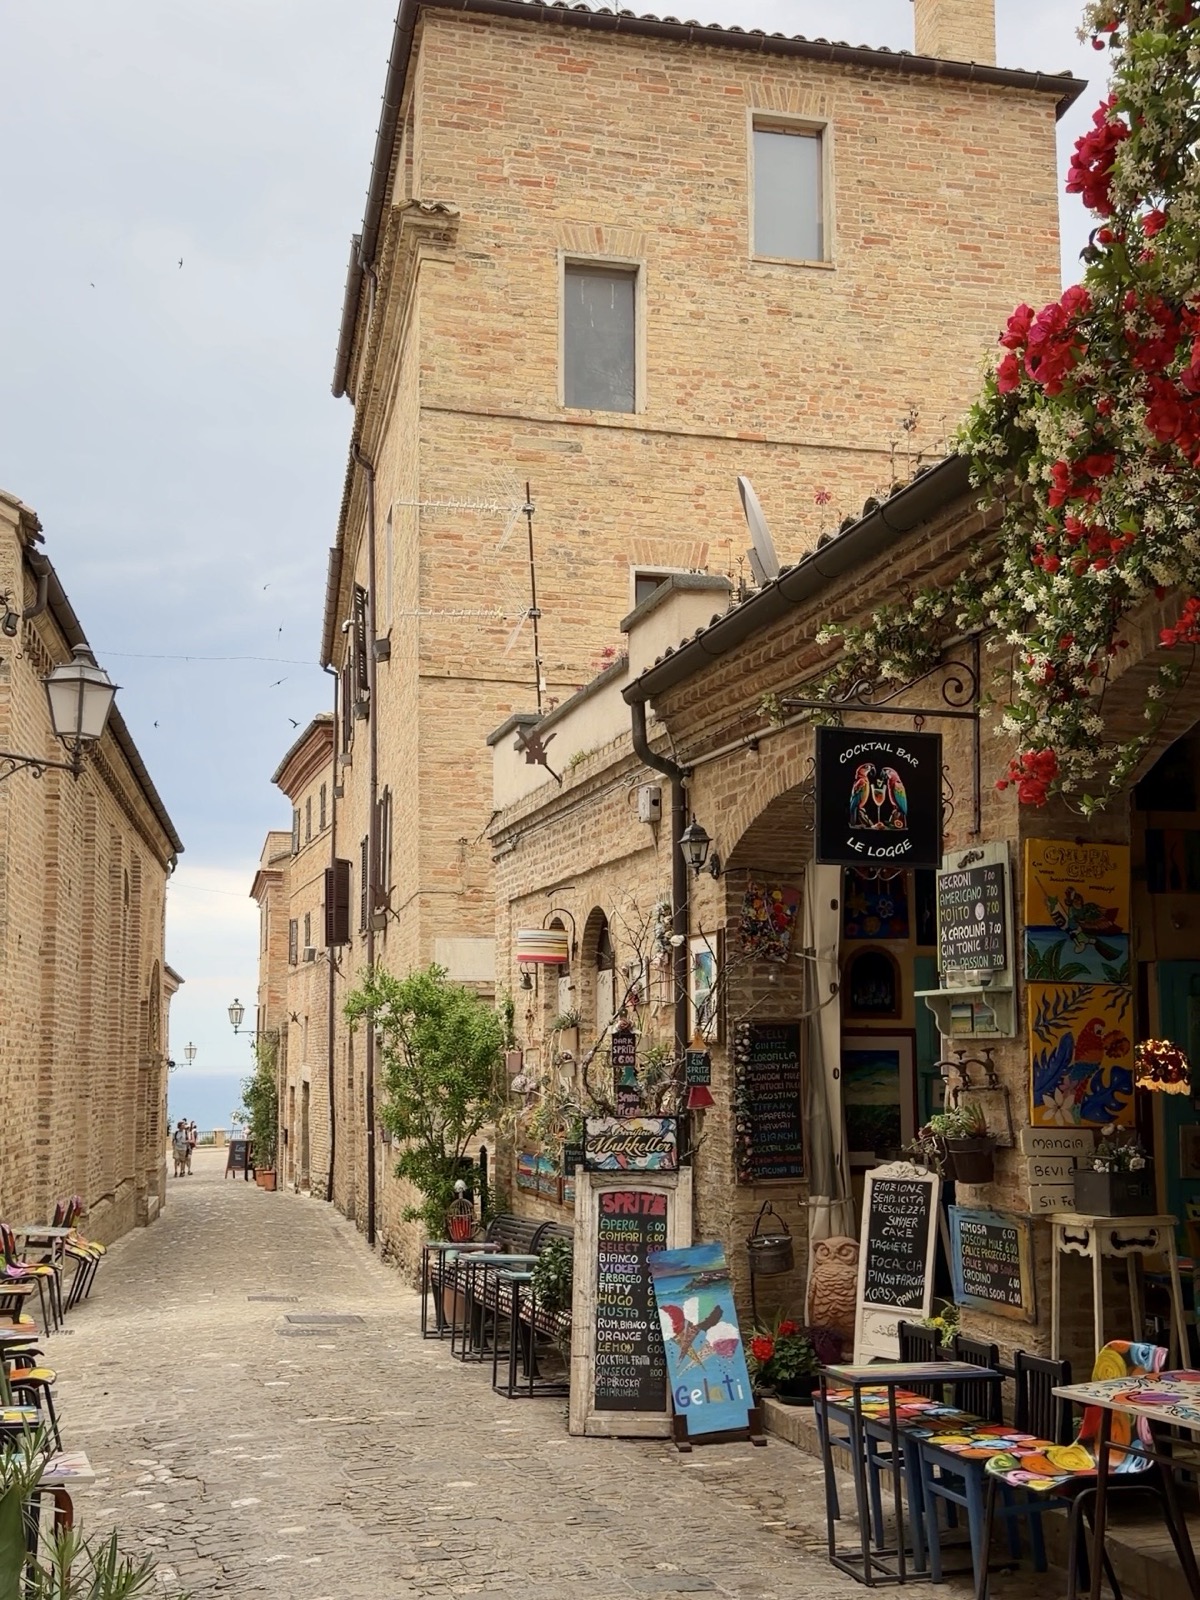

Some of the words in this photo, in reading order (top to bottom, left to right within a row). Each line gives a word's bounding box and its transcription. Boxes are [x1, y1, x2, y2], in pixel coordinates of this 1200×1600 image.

[839, 742, 893, 764] COCKTAIL
[896, 748, 919, 768] BAR
[846, 837, 865, 853] LE
[867, 838, 912, 858] LOGGE
[939, 872, 971, 892] NEGRONI
[939, 886, 982, 906] AMERICANO
[948, 921, 986, 941] CAROLINA
[941, 944, 955, 958] GIN
[956, 939, 981, 955] TONIC
[960, 954, 989, 970] PASSION
[613, 1045, 635, 1054] SPRITZ
[687, 1066, 709, 1074] SPRITZ
[759, 1121, 791, 1131] HAWAII
[760, 1131, 797, 1142] BIANCHI
[587, 1136, 672, 1157] Mukkeller
[1034, 1165, 1063, 1177] BEVI
[874, 1182, 924, 1193] EMOZIONE
[602, 1193, 667, 1216] SPRITZ
[872, 1203, 926, 1215] FRESCHEZZA
[600, 1219, 640, 1231] APEROL
[885, 1215, 918, 1228] SUMMER
[881, 1227, 914, 1238] CAKE
[960, 1222, 987, 1236] MIMOSA
[599, 1231, 642, 1243] CAMPARI
[599, 1242, 640, 1253] SELECT
[870, 1239, 913, 1254] TAGLIERE
[988, 1238, 1003, 1251] MULE
[599, 1253, 638, 1264] BIANCO
[961, 1244, 981, 1258] CALICE
[981, 1247, 1006, 1262] PROSECCO
[871, 1255, 923, 1272] FOCACCIA
[962, 1256, 982, 1272] CALICE
[985, 1262, 999, 1274] VINO
[599, 1273, 642, 1284] ERBACEO
[868, 1270, 895, 1286] PINSA
[895, 1274, 926, 1286] FARCITA
[963, 1268, 991, 1284] CRODINO
[599, 1282, 631, 1295] FIFTY
[964, 1282, 988, 1298] CAMPARI
[989, 1287, 1006, 1301] SODA
[598, 1293, 633, 1306] HUGO
[865, 1287, 897, 1303] TOAST
[896, 1287, 924, 1307] PANINI
[597, 1305, 639, 1318] MUSTA
[619, 1321, 647, 1330] BIANCO
[597, 1331, 642, 1341] ORANGE
[596, 1353, 630, 1366] COCKTAIL
[675, 1375, 744, 1408] Gelati
